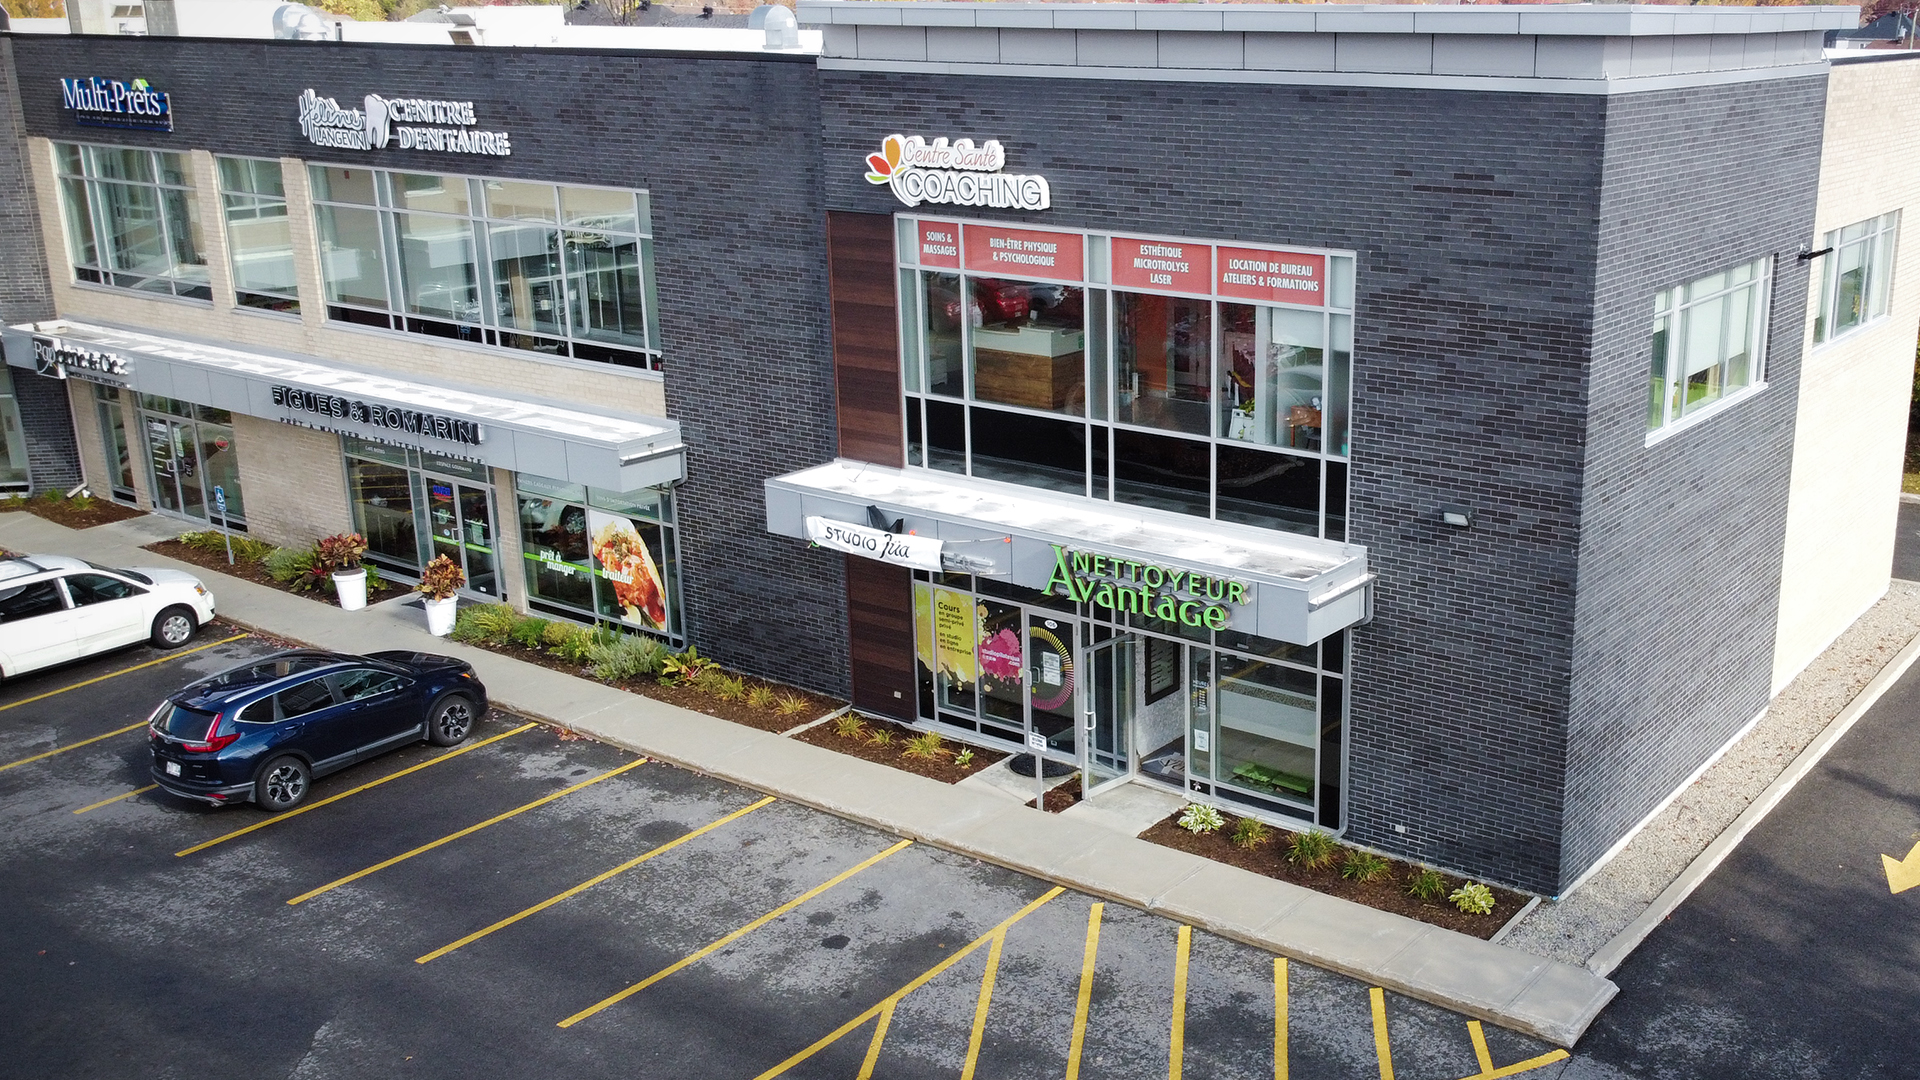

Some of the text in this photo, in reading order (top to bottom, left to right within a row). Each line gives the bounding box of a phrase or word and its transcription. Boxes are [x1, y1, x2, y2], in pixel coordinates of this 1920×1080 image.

[60, 77, 161, 116] Multi-Prêts
[388, 98, 477, 125] CENTRE
[315, 127, 371, 150] LANGEVIN
[398, 127, 511, 155] DENTAIRE
[903, 139, 998, 168] Centre Santé
[904, 172, 1043, 207] COACHING
[926, 231, 953, 243] SOINS &
[923, 244, 957, 256] MASSAGES
[989, 237, 1057, 254] BIEN-ÊTRE PHYSIQUE
[1140, 244, 1183, 259] ESTHÉTIQUE
[992, 251, 1055, 267] & PSYCHOLOGIQUE
[1133, 257, 1189, 273] MICROTROLYSE
[1229, 258, 1313, 276] LOCATION DE BUREAU
[1150, 273, 1172, 285] LASER
[1222, 272, 1319, 292] ATELIERS & FORMATIONS
[272, 385, 482, 445] FIGUES & ROMARIN
[825, 526, 877, 551] STUDIO
[540, 549, 555, 561] prêt
[547, 561, 576, 576] manger
[602, 567, 634, 585] traiteur
[1073, 550, 1246, 606] NETTOYEUR
[938, 602, 960, 614] Cours
[946, 612, 963, 620] groupe
[939, 617, 964, 627] semi-privé
[947, 633, 962, 641] studio
[947, 645, 972, 655] entreprise
